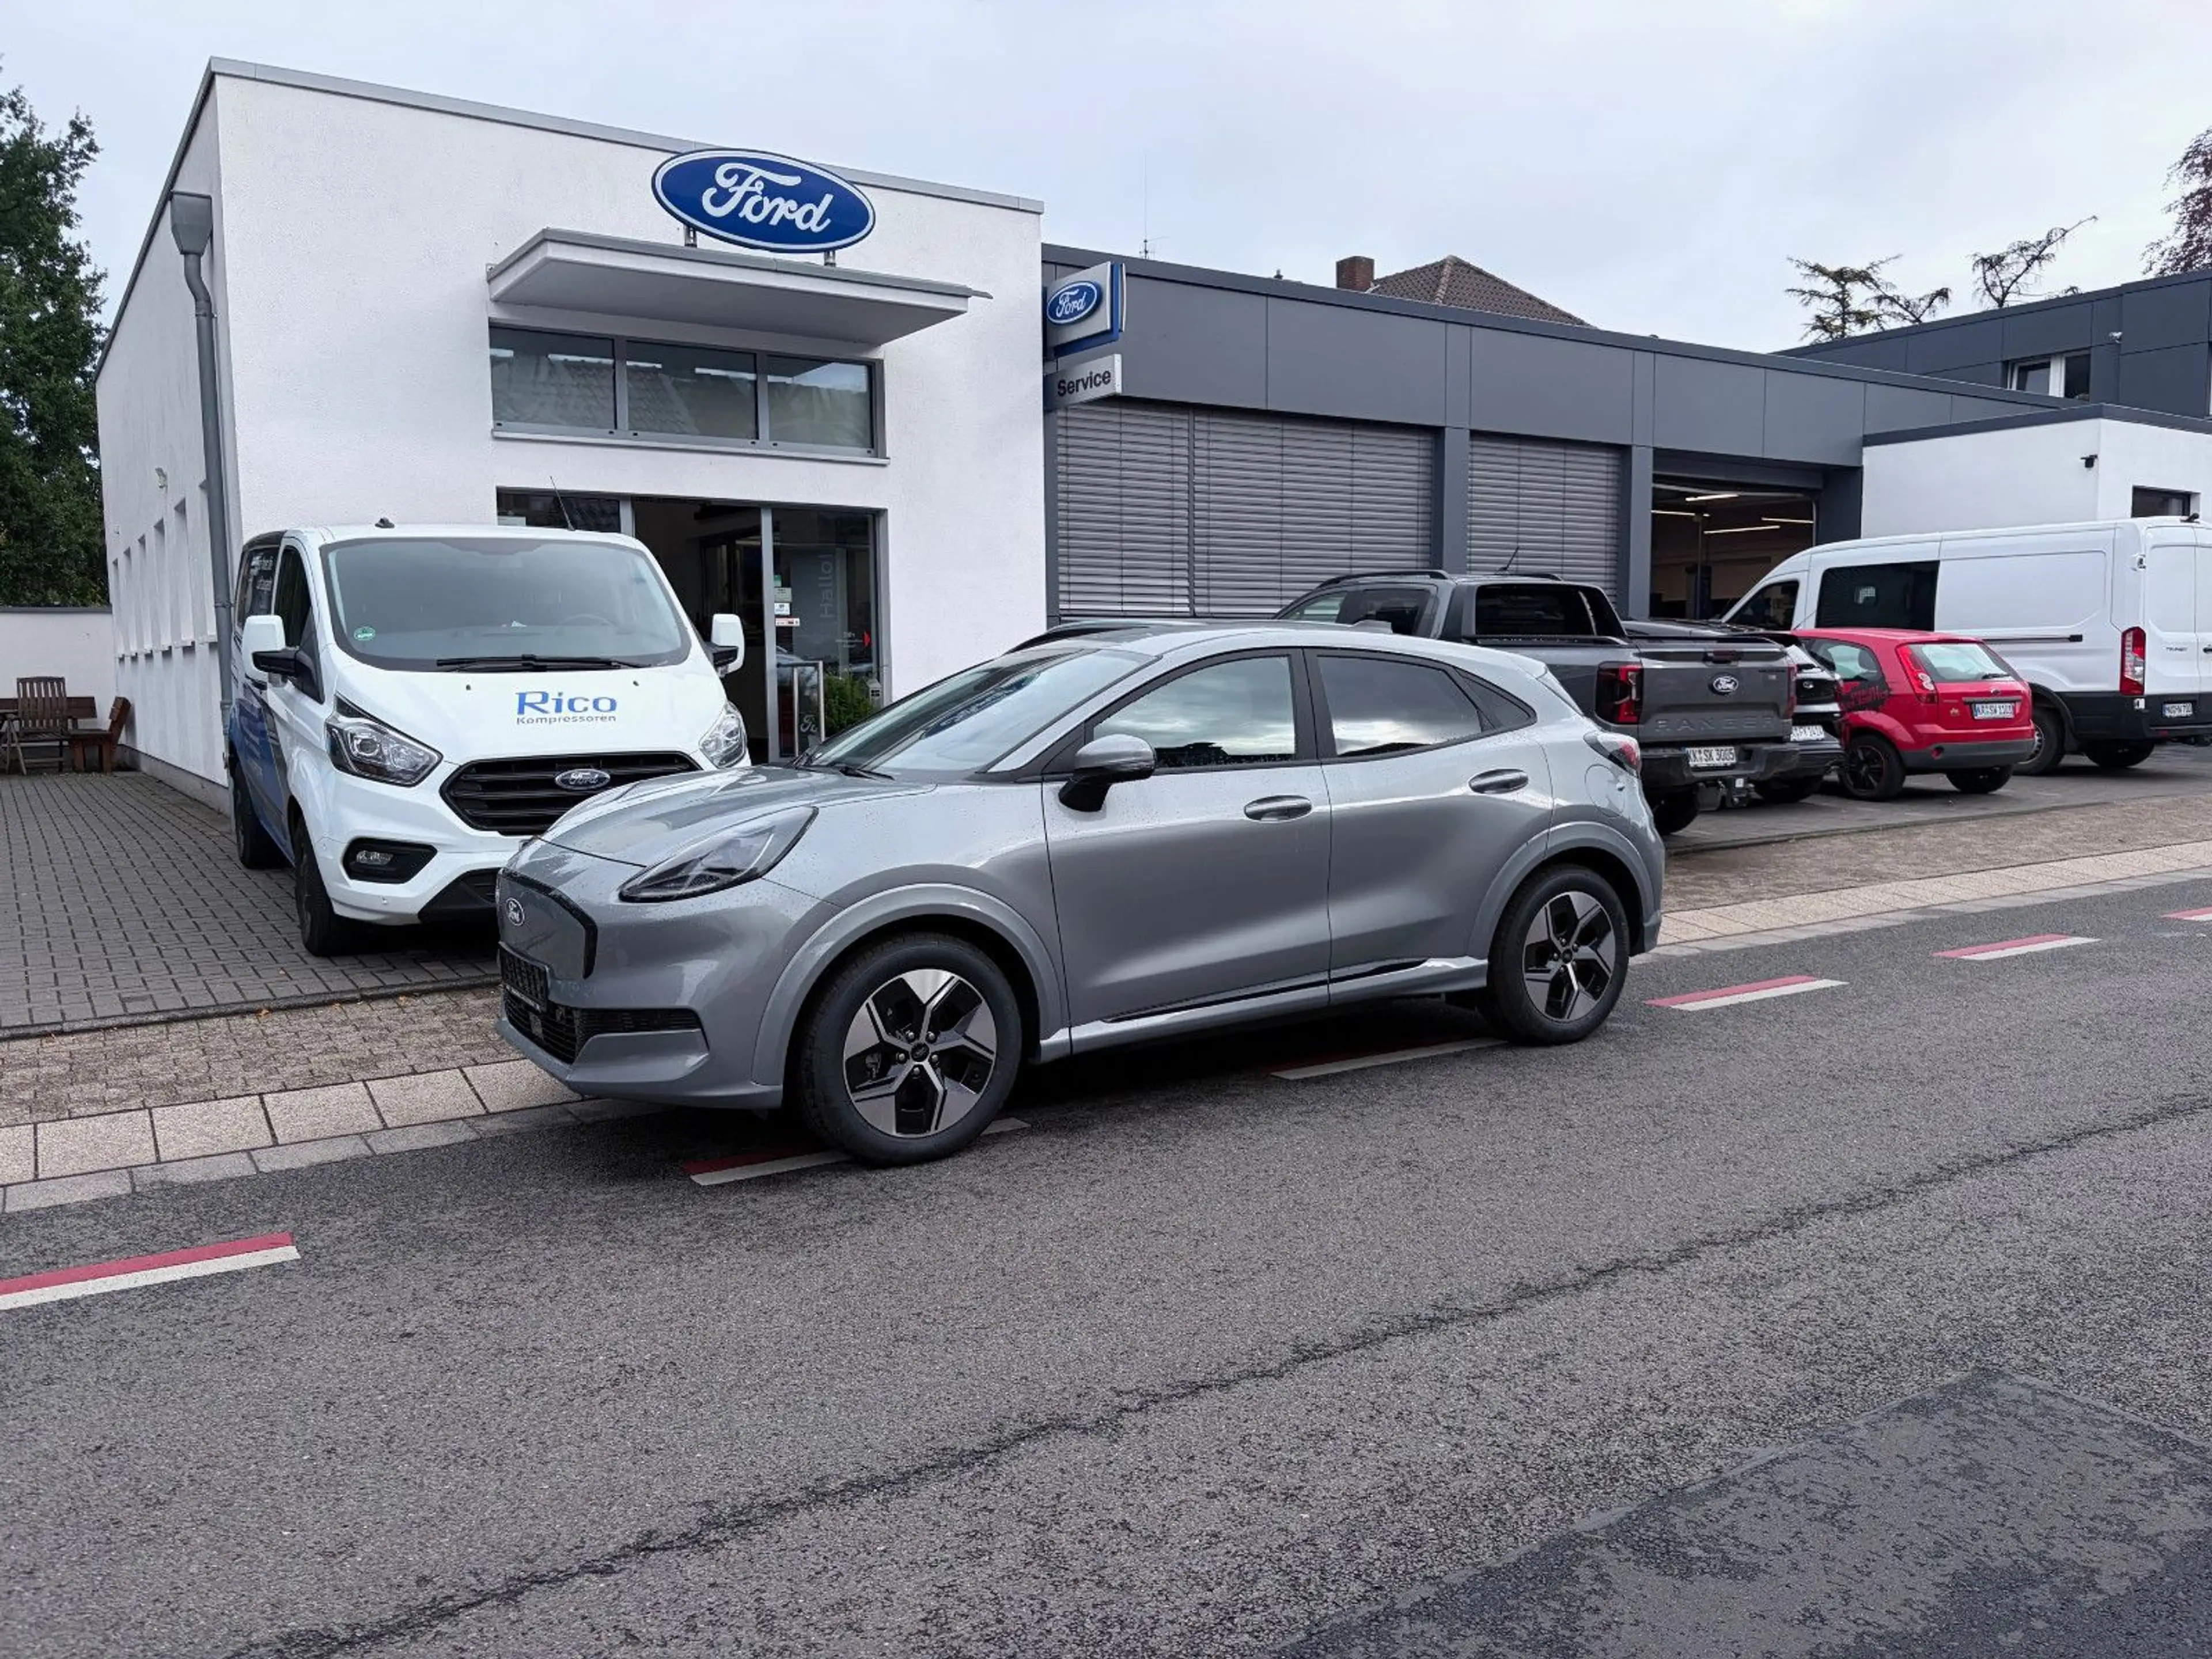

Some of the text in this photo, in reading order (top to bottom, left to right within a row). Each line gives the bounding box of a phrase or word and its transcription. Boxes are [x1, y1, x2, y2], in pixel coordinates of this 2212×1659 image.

[702, 162, 833, 233] Ford
[1055, 288, 1087, 317] Ford
[1057, 370, 1112, 396] Service
[515, 691, 617, 715] Rico
[517, 715, 616, 725] Kompressoren
[1654, 716, 1776, 732] RANGER
[568, 771, 599, 785] Ford
